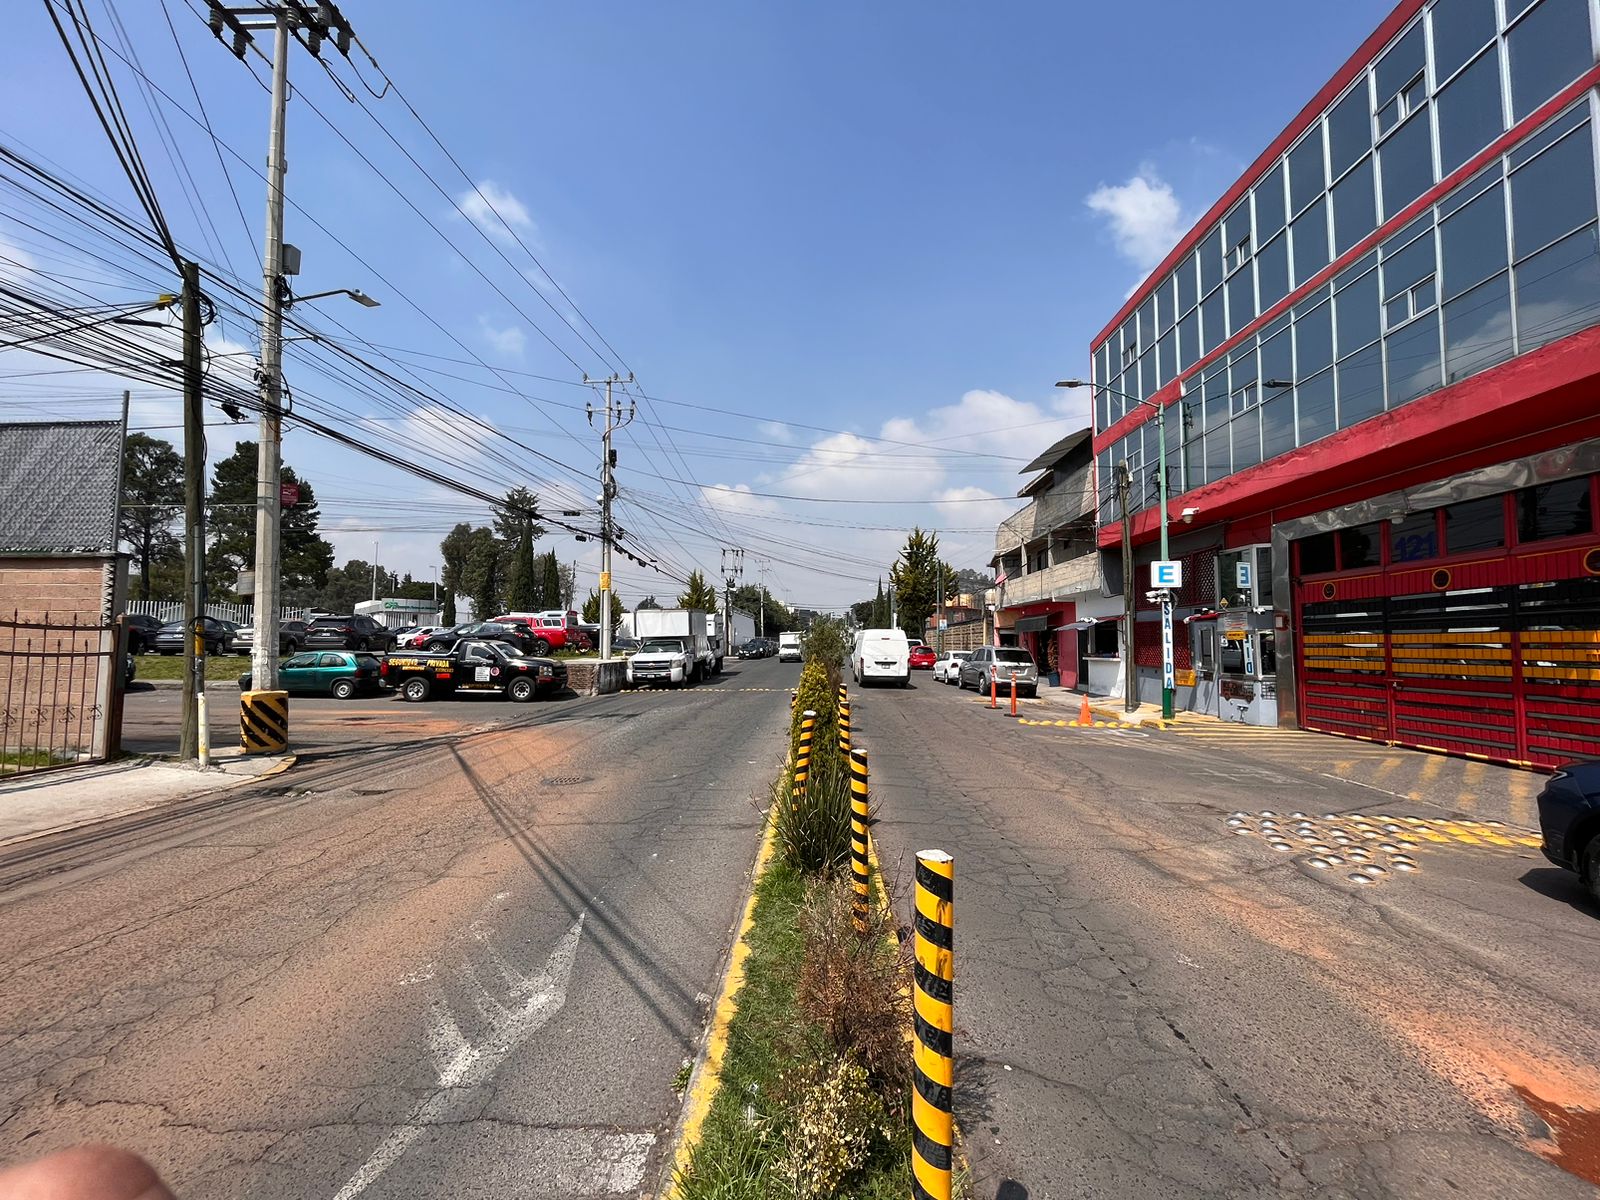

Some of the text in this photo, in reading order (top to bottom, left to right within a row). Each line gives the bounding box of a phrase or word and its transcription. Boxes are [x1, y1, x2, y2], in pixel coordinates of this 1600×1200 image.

[1395, 532, 1435, 561] 121
[1158, 565, 1174, 583] E
[1163, 602, 1173, 689] SALIDA
[426, 659, 450, 668] PRIVADA
